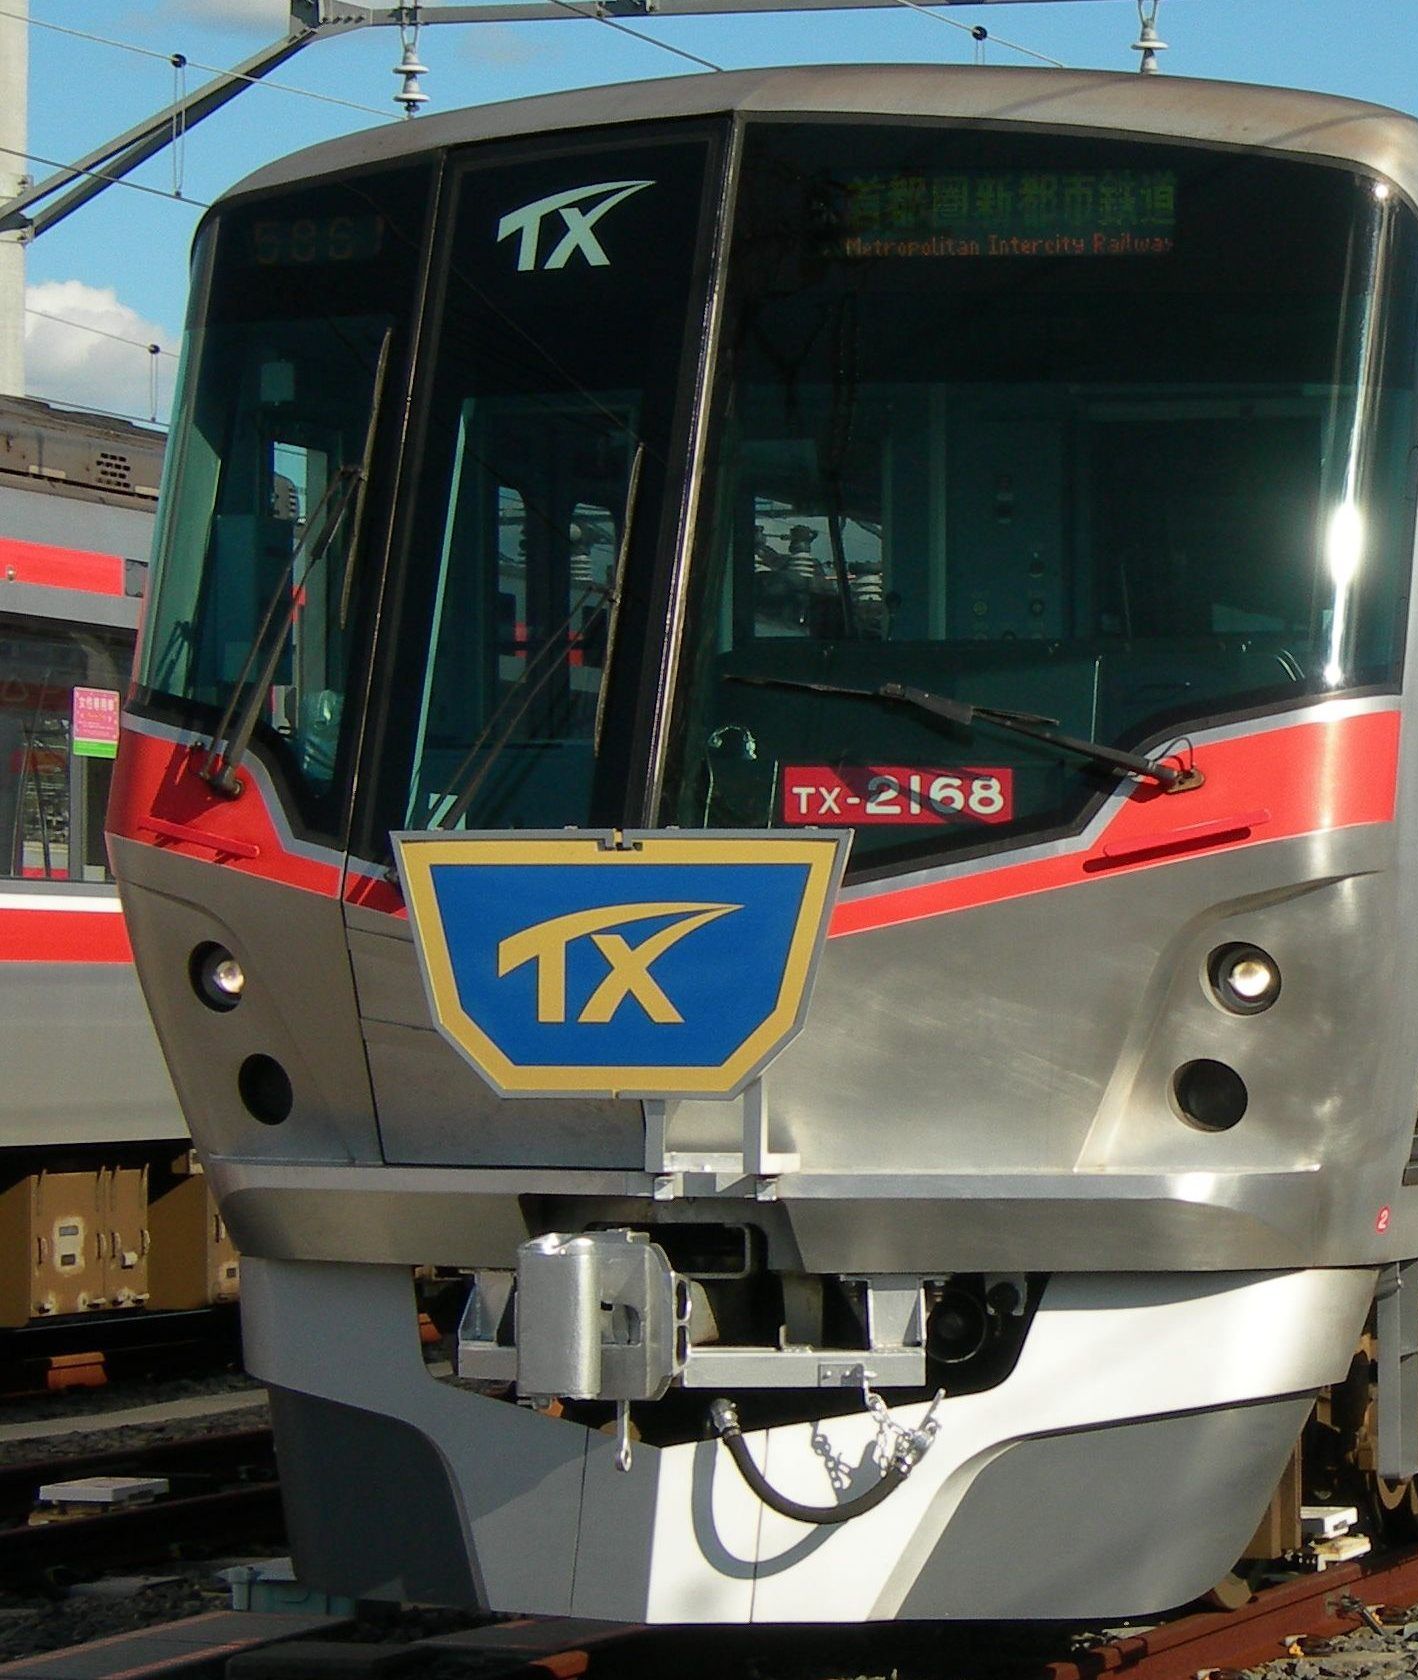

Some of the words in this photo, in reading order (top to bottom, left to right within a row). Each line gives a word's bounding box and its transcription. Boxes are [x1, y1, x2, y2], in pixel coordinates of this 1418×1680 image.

[497, 180, 657, 272] TX
[845, 236, 980, 257] Metropolitan
[988, 233, 1085, 256] Intercity
[791, 773, 1005, 816] TX-2168
[497, 901, 745, 1024] TX
[1377, 1208, 1389, 1229] 2
